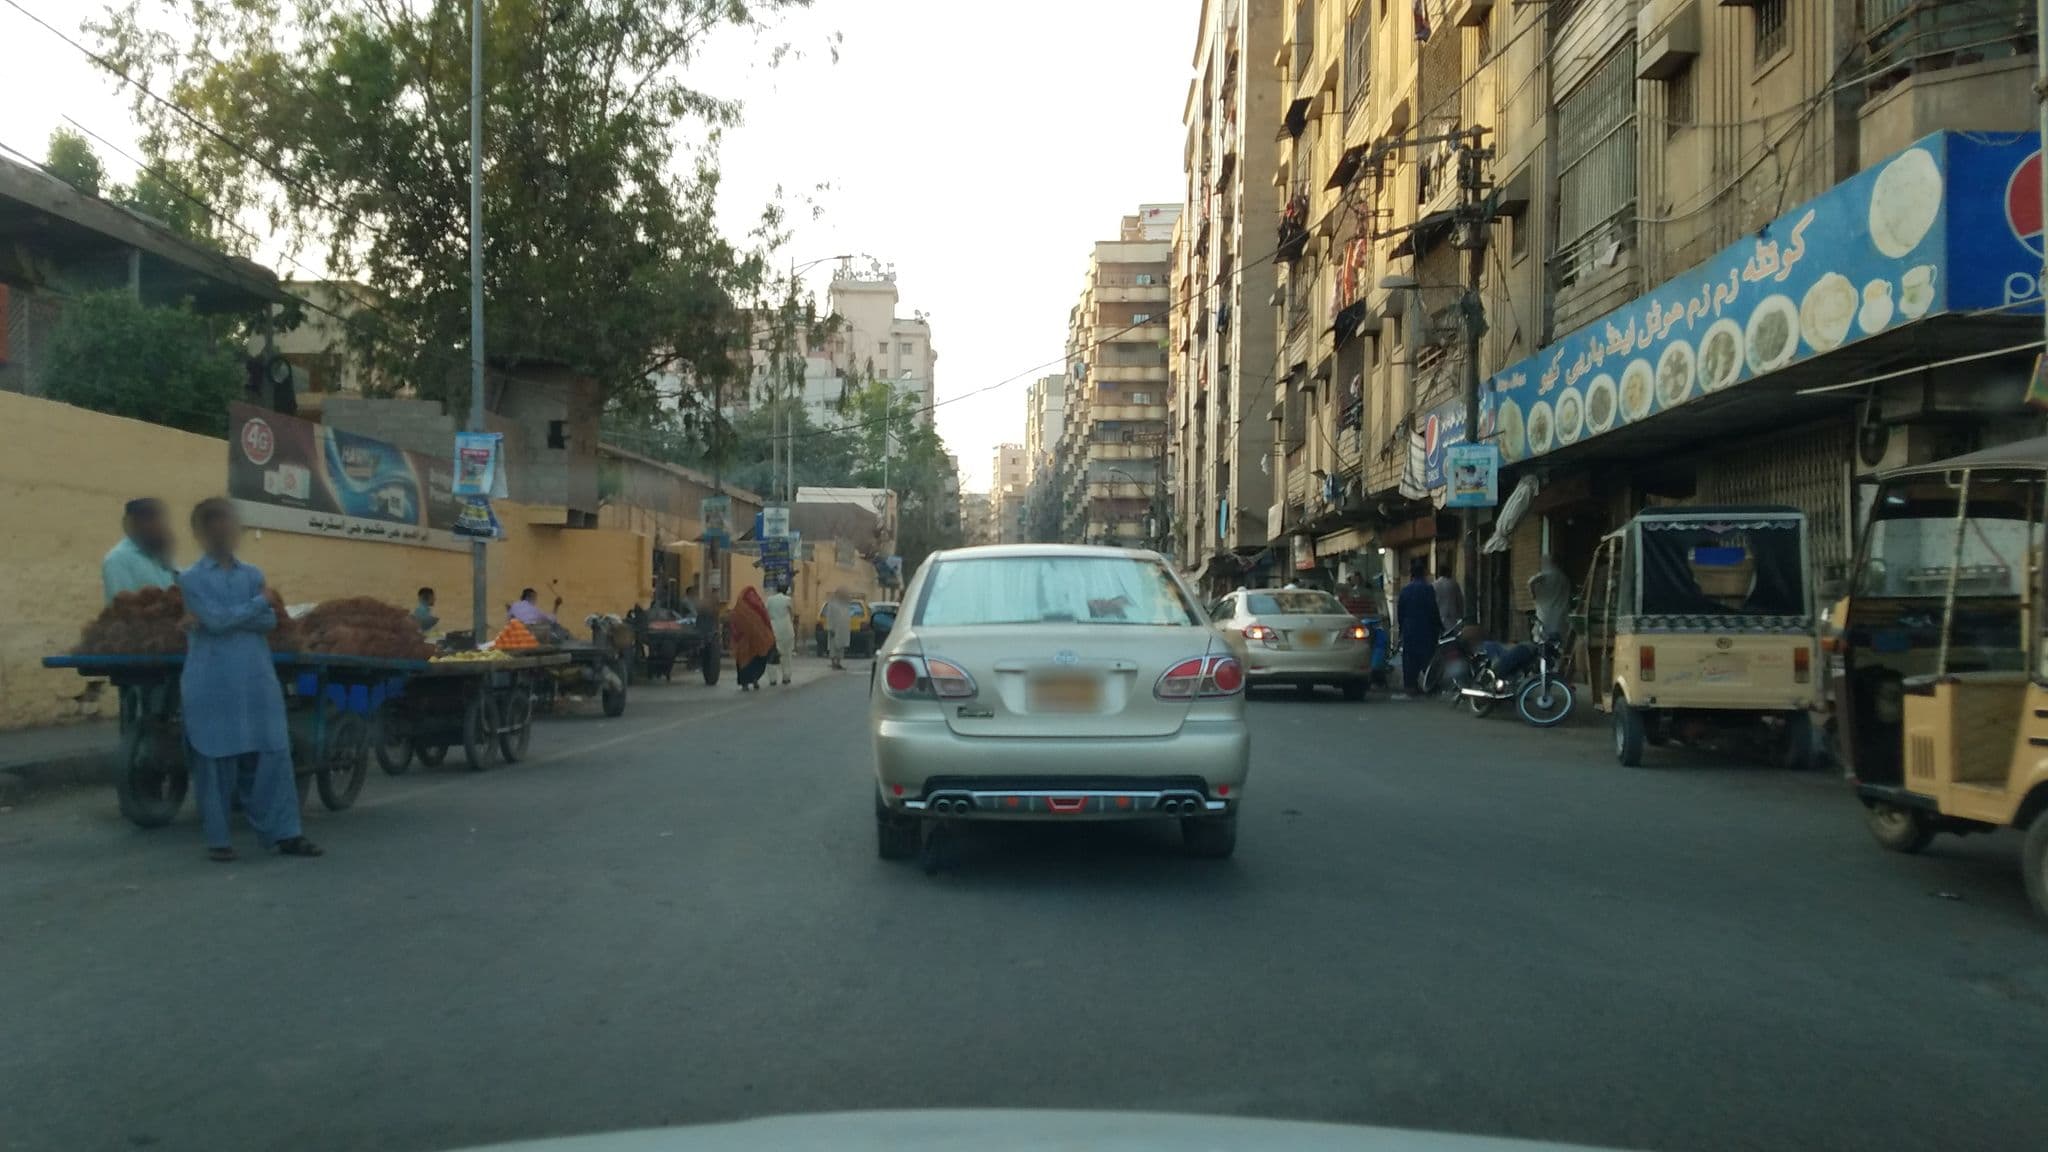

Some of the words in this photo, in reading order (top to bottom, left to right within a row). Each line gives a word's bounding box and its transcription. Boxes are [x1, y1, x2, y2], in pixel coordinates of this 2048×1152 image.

[1687, 283, 1711, 330] زم
[1714, 267, 1739, 318] زم
[247, 423, 269, 449] 4G
